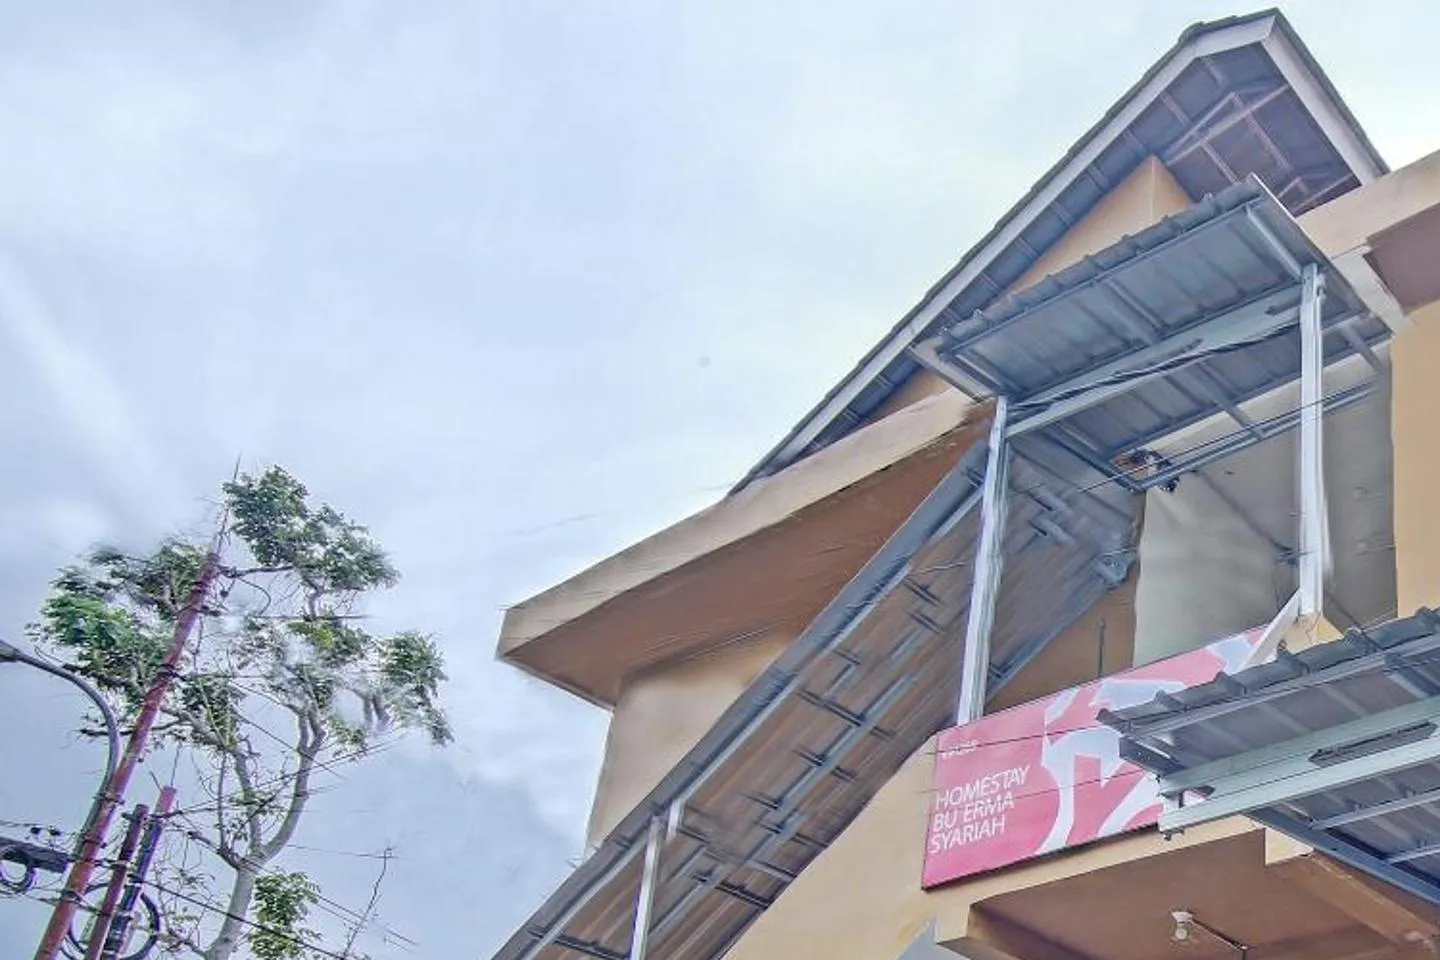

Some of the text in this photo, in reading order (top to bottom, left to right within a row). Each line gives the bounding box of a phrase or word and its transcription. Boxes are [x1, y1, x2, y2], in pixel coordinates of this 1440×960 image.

[935, 764, 1031, 811] HOMESTAY
[932, 791, 1015, 833] BU ERMA
[927, 814, 1006, 854] SYARIAH
